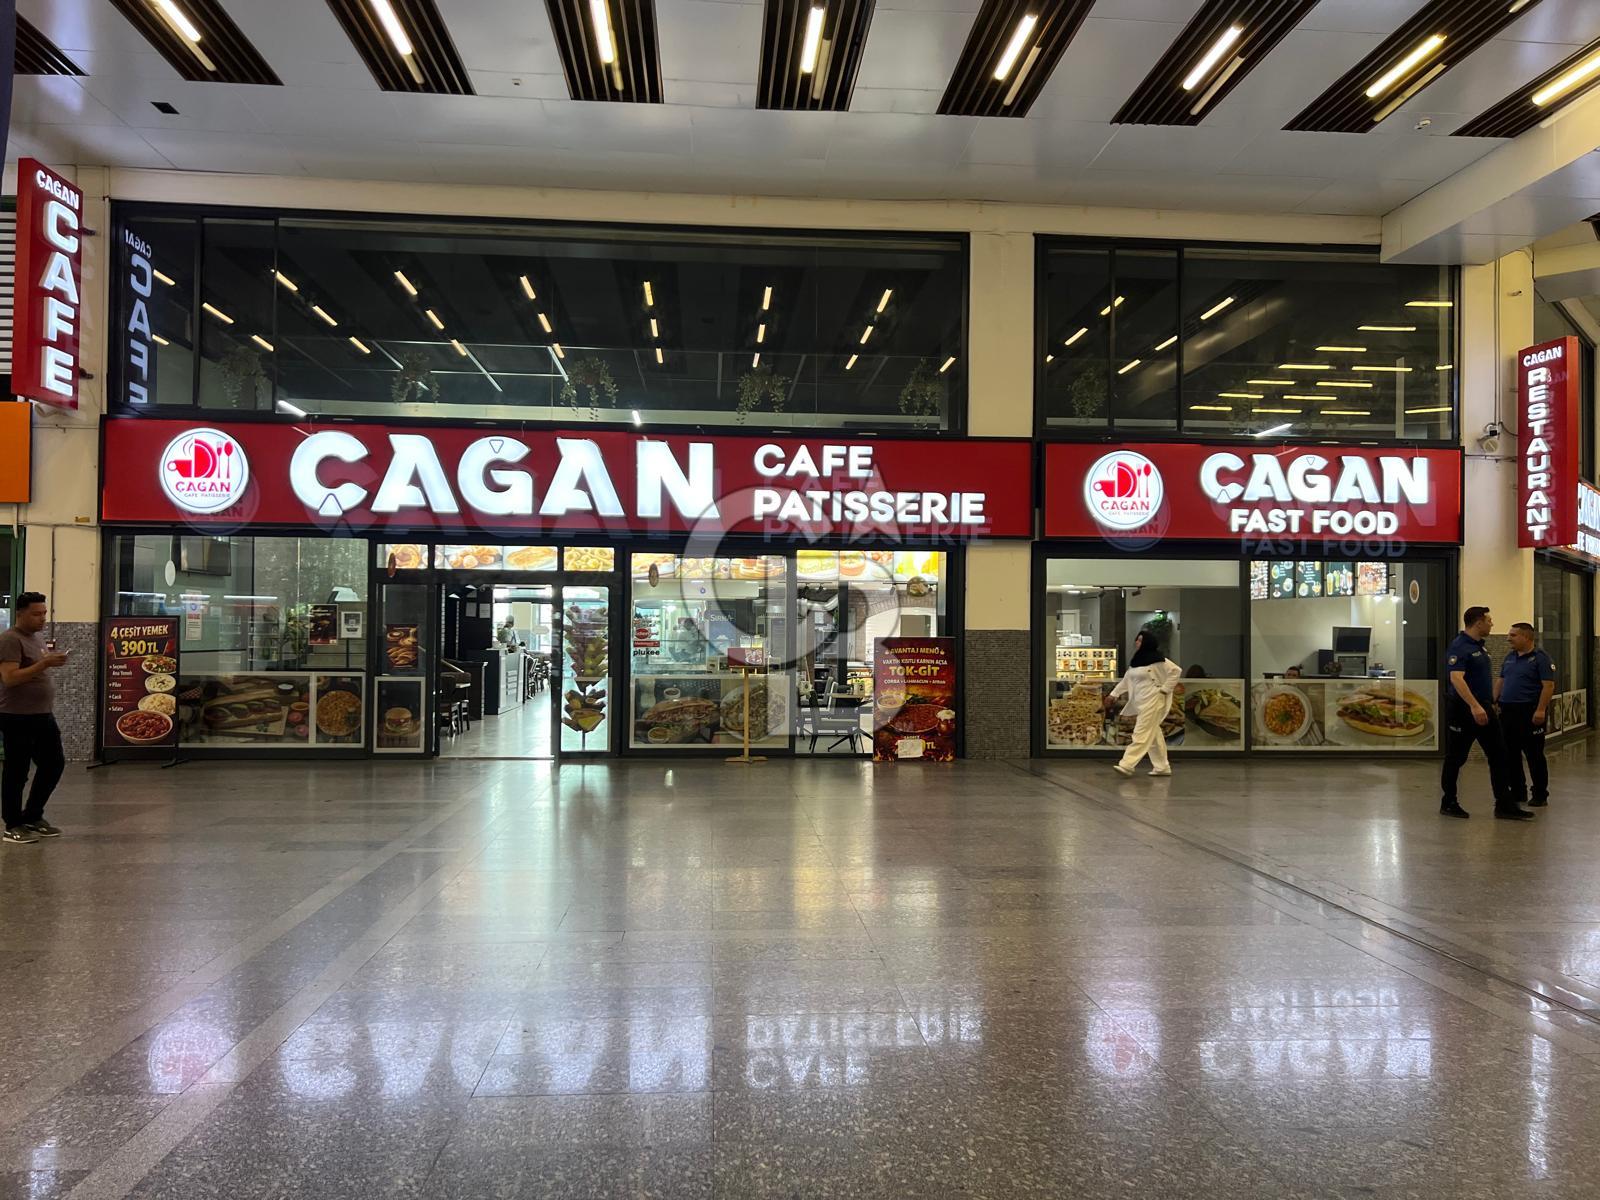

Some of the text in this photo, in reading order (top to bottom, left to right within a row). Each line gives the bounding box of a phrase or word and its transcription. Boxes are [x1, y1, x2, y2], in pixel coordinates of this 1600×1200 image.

[39, 200, 79, 397] CAFE
[754, 444, 873, 477] CAFE
[1526, 367, 1548, 541] RESTAURANT
[754, 489, 986, 524] PATISSERIE
[1231, 509, 1398, 535] FAST FOOD
[110, 626, 118, 639] 4
[142, 624, 169, 636] YEMEK
[120, 640, 158, 656] 390 TL
[890, 647, 918, 655] AVANTAJ
[888, 665, 940, 676] TOK-GİT
